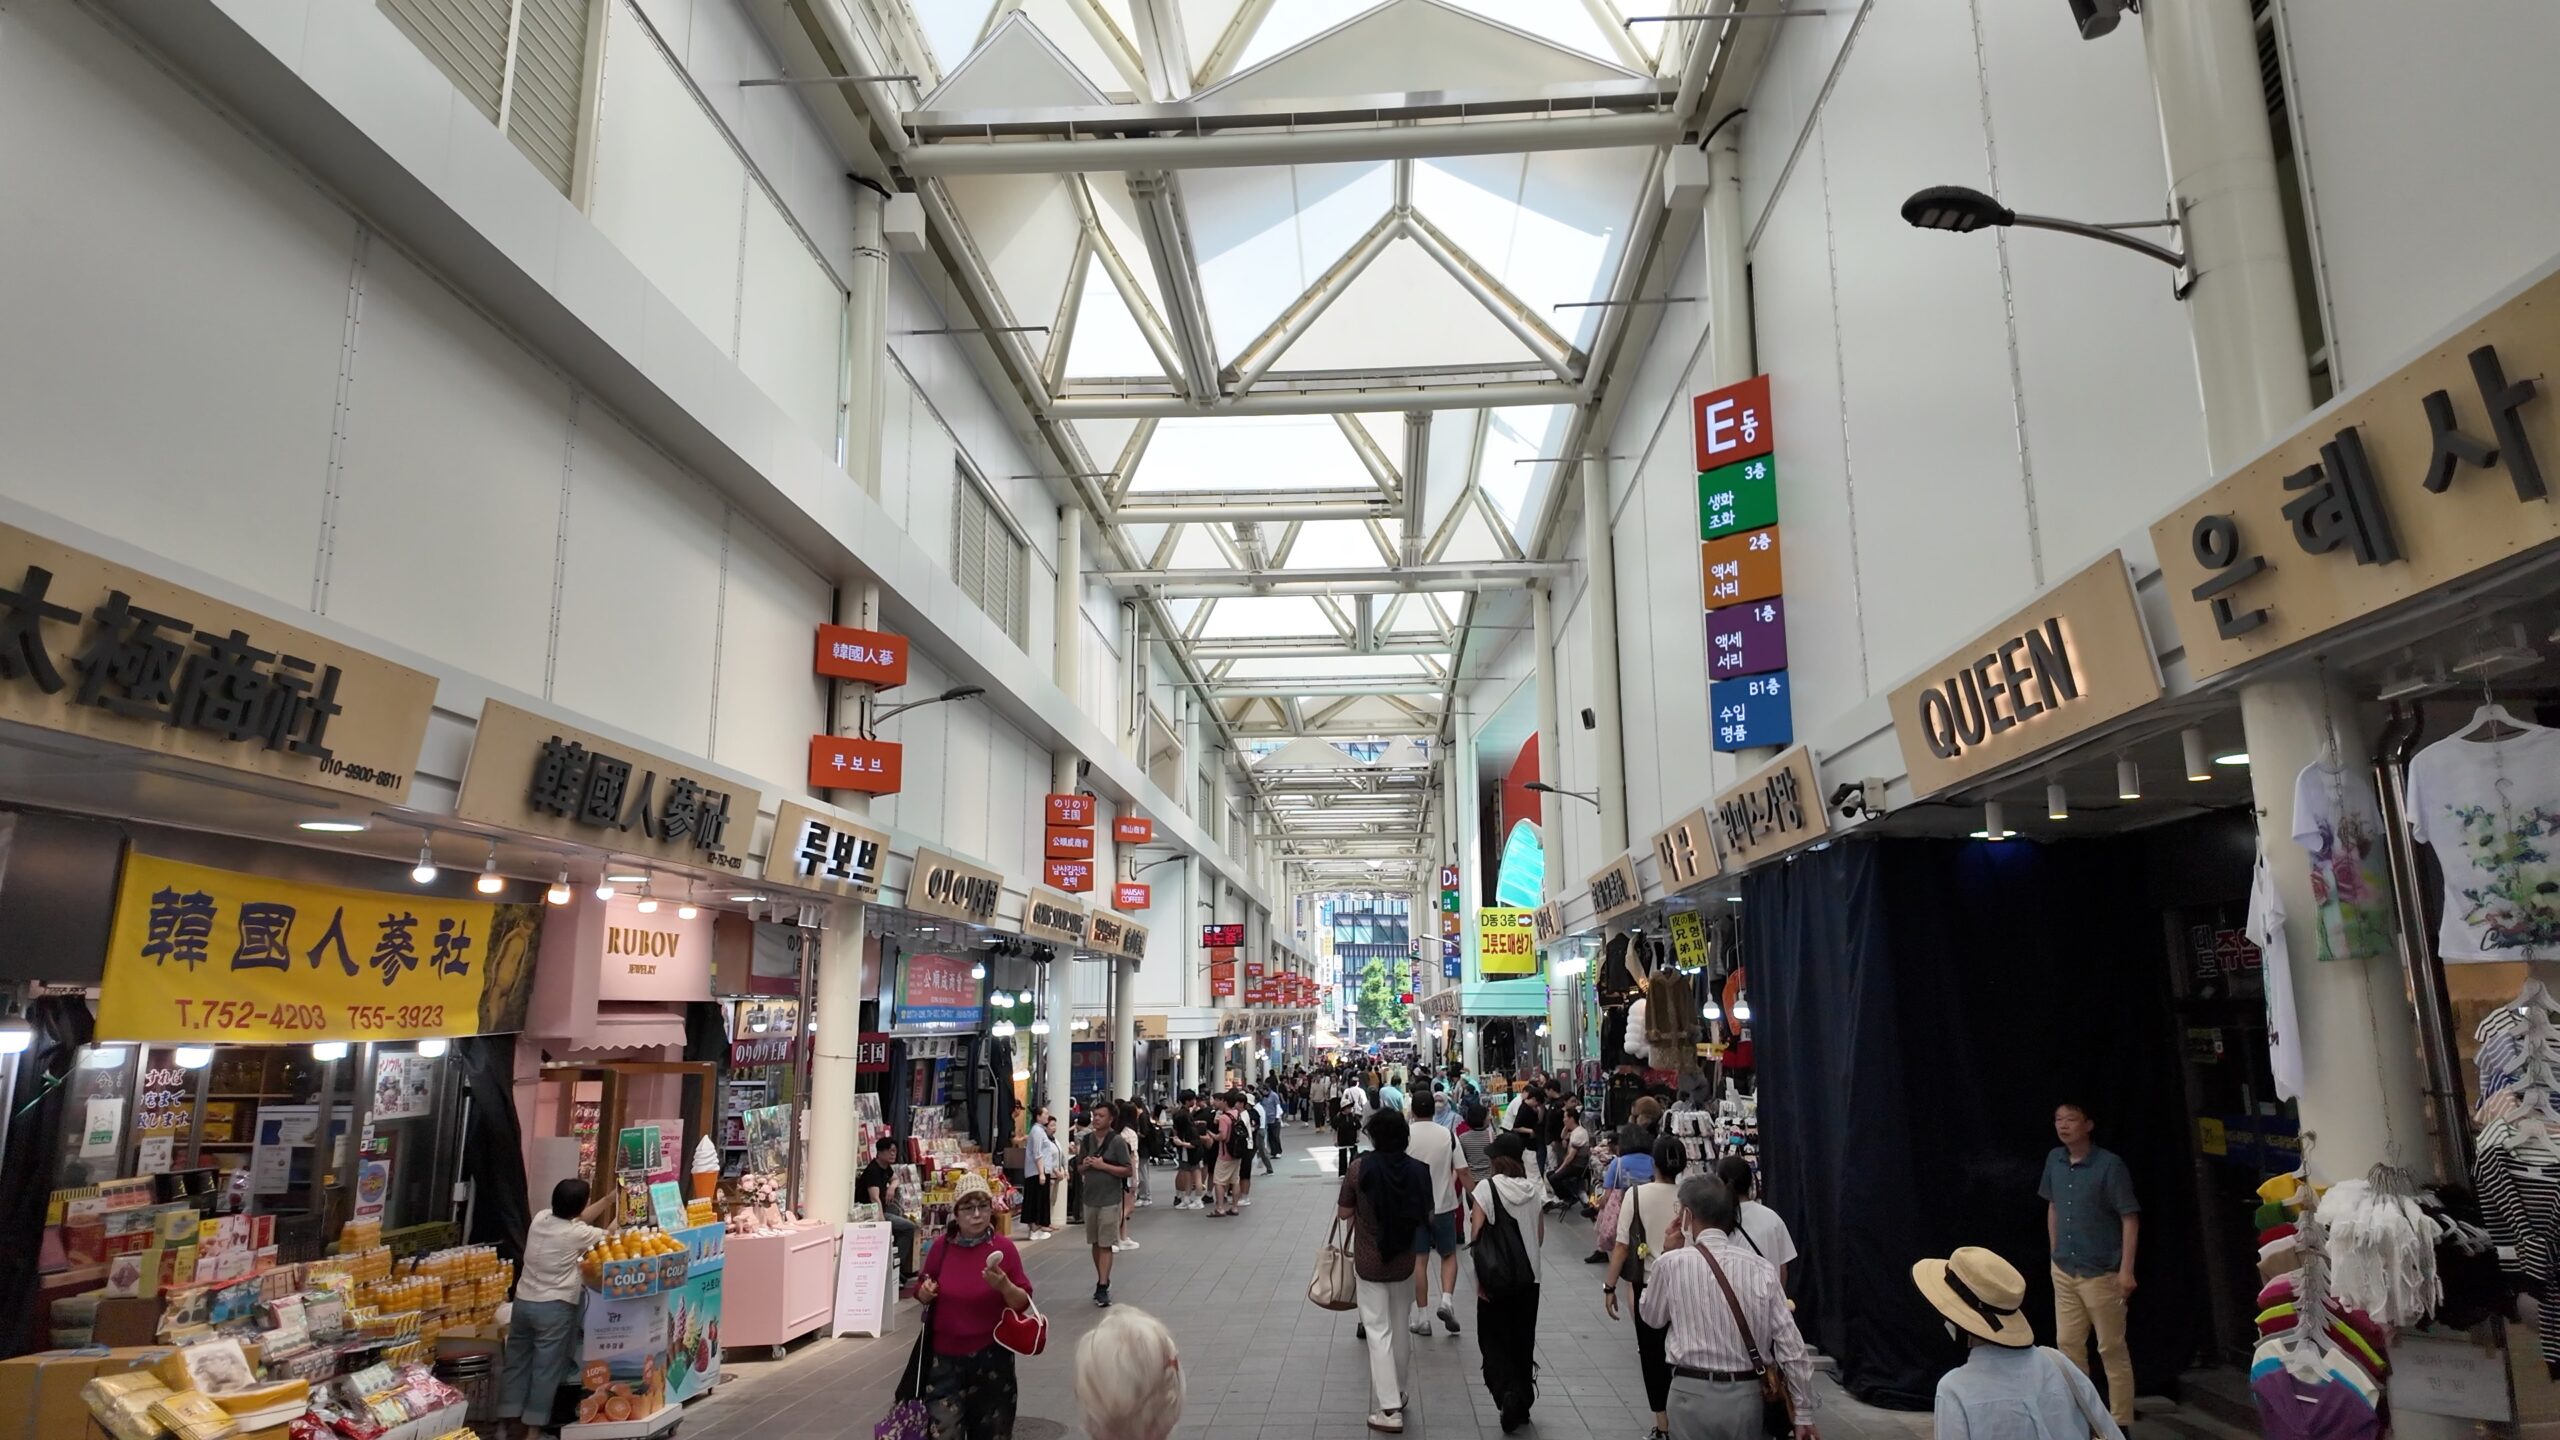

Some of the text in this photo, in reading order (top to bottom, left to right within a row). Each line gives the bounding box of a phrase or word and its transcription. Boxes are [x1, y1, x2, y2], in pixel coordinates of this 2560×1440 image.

[1745, 462, 1767, 480] 3층
[1708, 490, 1735, 510] 생화
[2192, 345, 2547, 640] 은혜사
[1708, 510, 1736, 529] 조화
[1749, 533, 1771, 551] 2층
[1711, 560, 1738, 578] 액세
[1712, 580, 1739, 598] 사리
[1753, 604, 1776, 622] 1층
[1715, 630, 1743, 649] 액세
[1717, 651, 1744, 670] 서리
[1749, 677, 1781, 696] B1층
[1919, 616, 2080, 759] QUEEN
[1720, 703, 1746, 723] 수입
[1720, 725, 1748, 743] 명품
[319, 756, 403, 790] 010-9900-8811
[1054, 798, 1089, 809] のりのり
[1062, 809, 1080, 820] 王国
[801, 821, 879, 883] 루보브
[1120, 887, 1145, 896] NAMSAN
[1481, 914, 1517, 927] D동 3층
[607, 926, 680, 957] RUBOV
[1482, 933, 1533, 955] 그릇도매상가
[174, 999, 444, 1030] T.752-4203 755-3923
[614, 1272, 646, 1287] COLD
